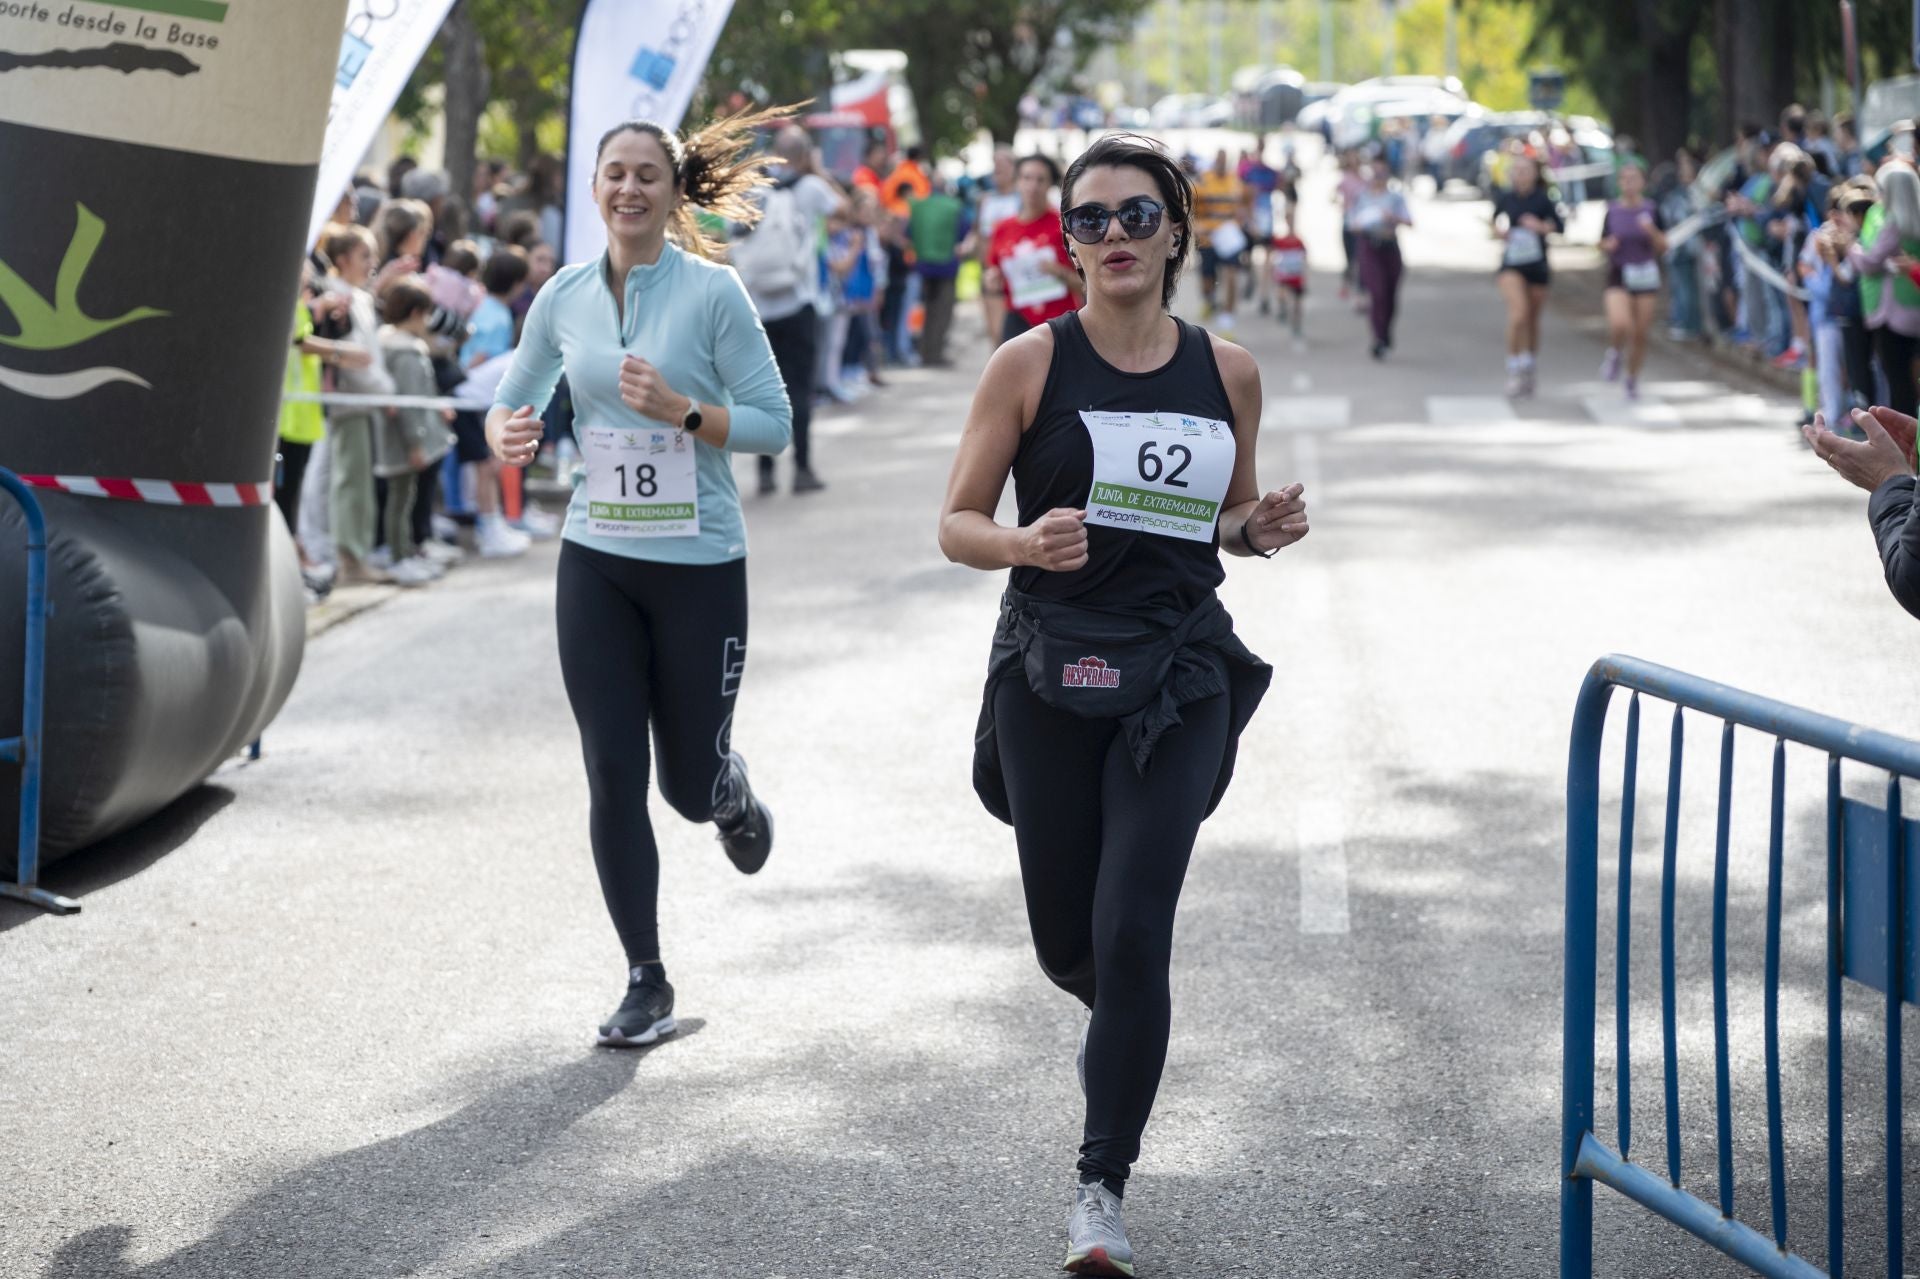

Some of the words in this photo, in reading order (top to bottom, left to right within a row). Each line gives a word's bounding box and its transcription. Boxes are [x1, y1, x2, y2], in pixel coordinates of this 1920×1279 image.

[57, 5, 127, 35] desde
[135, 16, 157, 40] la
[166, 23, 219, 49] Base
[1138, 441, 1192, 488] 62
[615, 463, 658, 498] 18
[613, 507, 622, 518] DE
[626, 505, 692, 518] EXTREMADURA
[1096, 487, 1123, 503] JUNTA
[1128, 492, 1141, 505] DE
[1143, 495, 1211, 518] EXTREMADURA
[1096, 508, 1201, 534] #deporteresponsable
[1063, 664, 1120, 688] DESPERADOS
